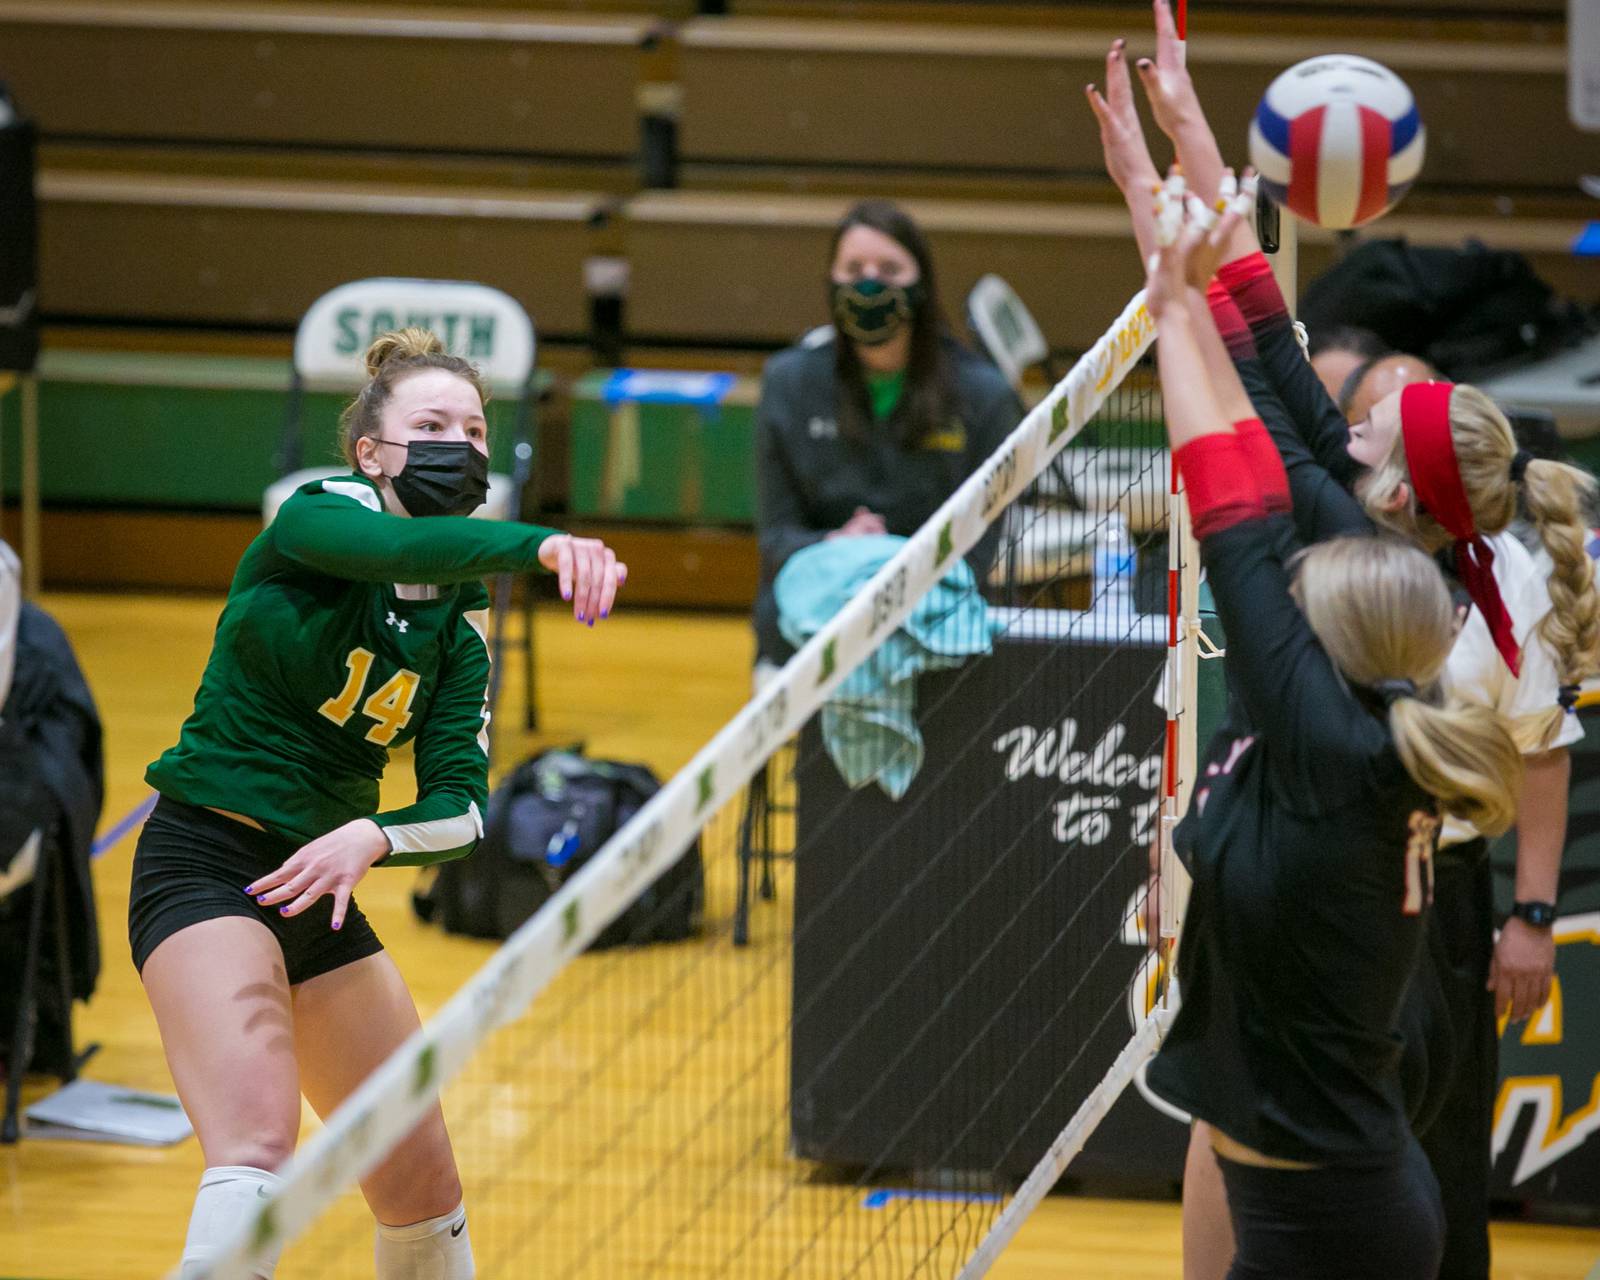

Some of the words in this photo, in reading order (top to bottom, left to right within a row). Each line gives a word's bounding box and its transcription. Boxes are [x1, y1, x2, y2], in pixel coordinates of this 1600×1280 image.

[317, 646, 421, 746] 14
[993, 717, 1162, 790] Welco
[1052, 791, 1121, 846] to
